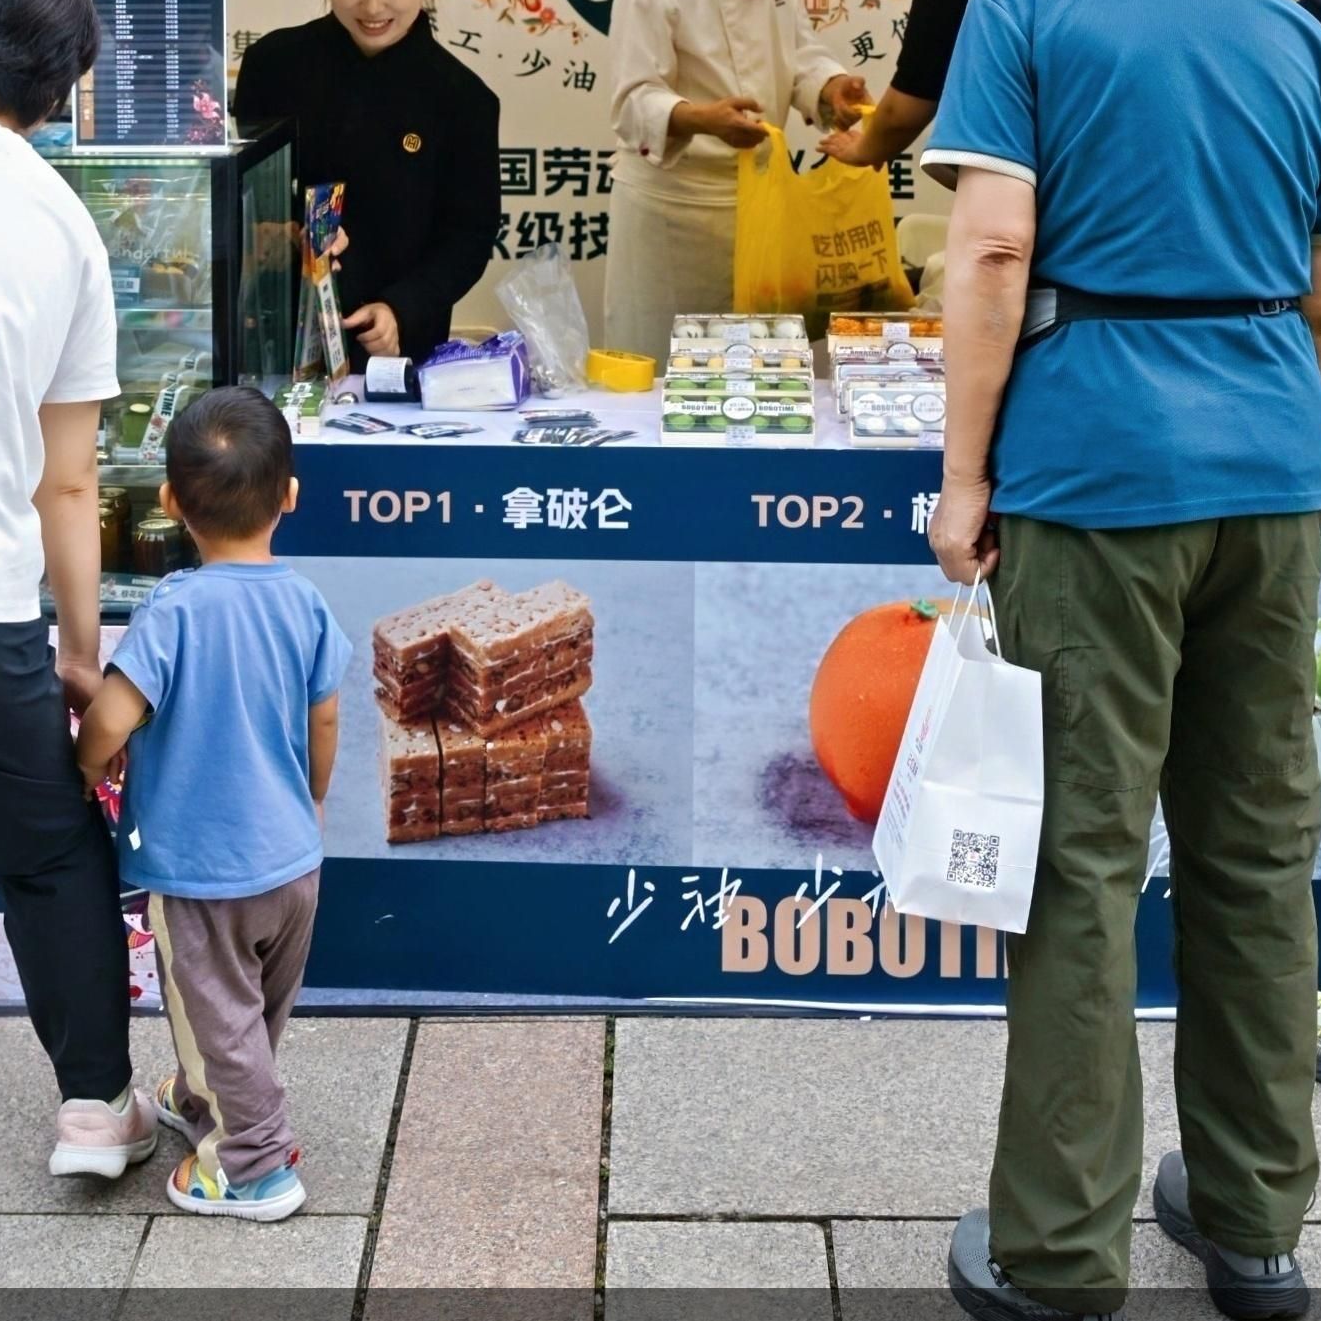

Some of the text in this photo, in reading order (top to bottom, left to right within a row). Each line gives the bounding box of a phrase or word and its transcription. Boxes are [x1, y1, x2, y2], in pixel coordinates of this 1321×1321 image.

[427, 6, 597, 92] 工·少油
[811, 219, 885, 259] 吃的用的
[815, 248, 889, 291] 闪购一下
[343, 487, 633, 530] TOP1 拿破仑
[750, 494, 865, 529] TOP2
